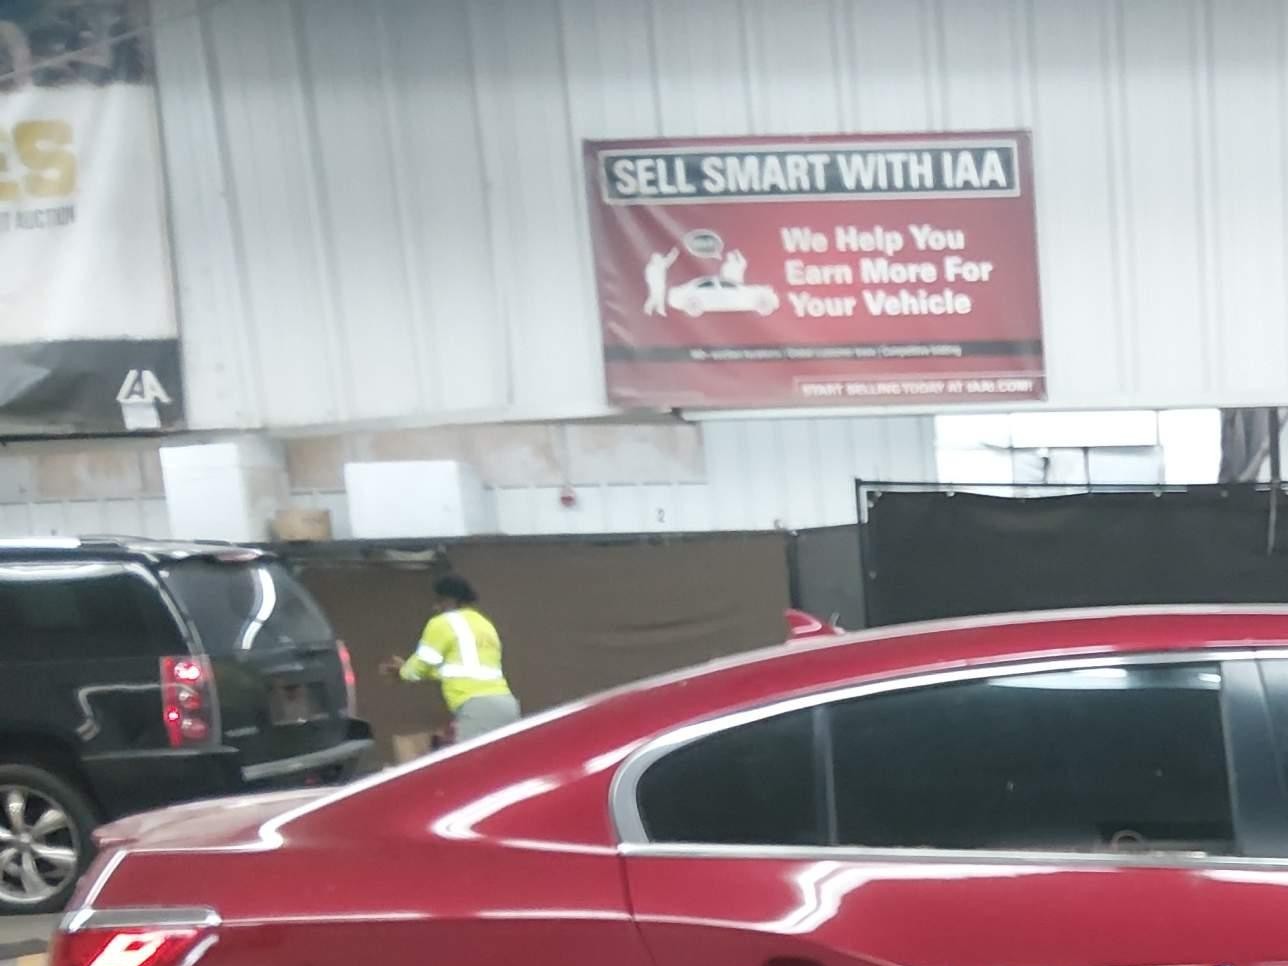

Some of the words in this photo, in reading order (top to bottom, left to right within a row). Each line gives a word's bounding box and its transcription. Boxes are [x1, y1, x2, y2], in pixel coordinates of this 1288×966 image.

[613, 157, 697, 196] SELL
[701, 153, 831, 193] SMART
[836, 152, 934, 191] WITH
[941, 150, 1008, 188] IAA
[780, 226, 828, 253] We
[834, 224, 904, 257] Help
[908, 223, 966, 251] You
[785, 258, 853, 285] Earn
[859, 257, 938, 284] More
[943, 255, 994, 282] For
[787, 291, 857, 318] Your
[861, 288, 973, 316] Vehicle
